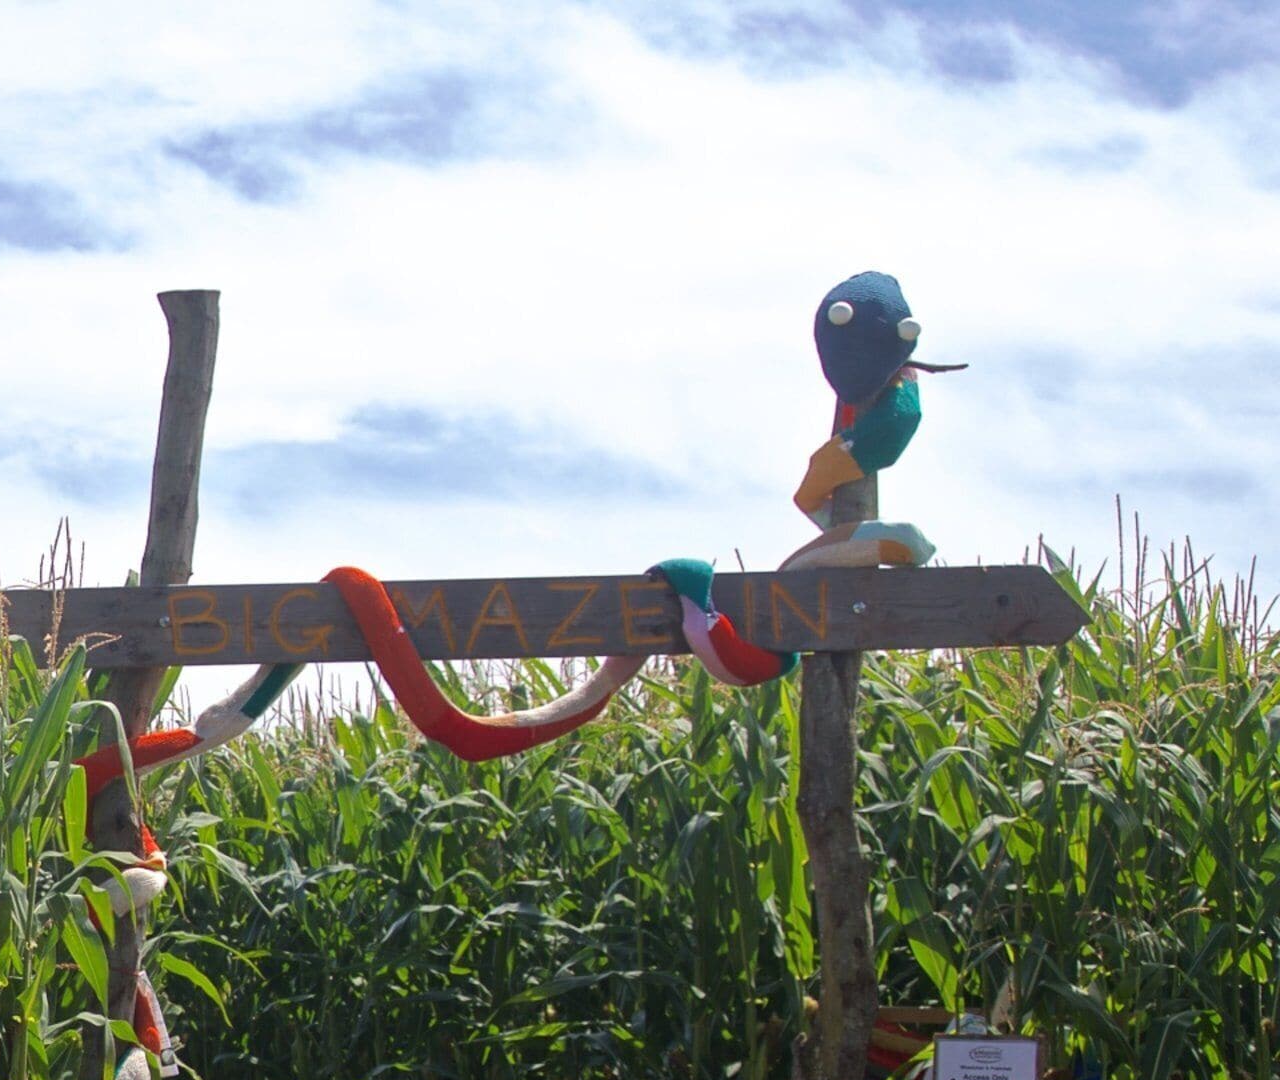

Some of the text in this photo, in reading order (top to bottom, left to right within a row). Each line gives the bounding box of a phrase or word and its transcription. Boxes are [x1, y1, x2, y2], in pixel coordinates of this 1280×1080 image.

[167, 577, 828, 656] BIG MAZE IN
[963, 1073, 990, 1080] Access
